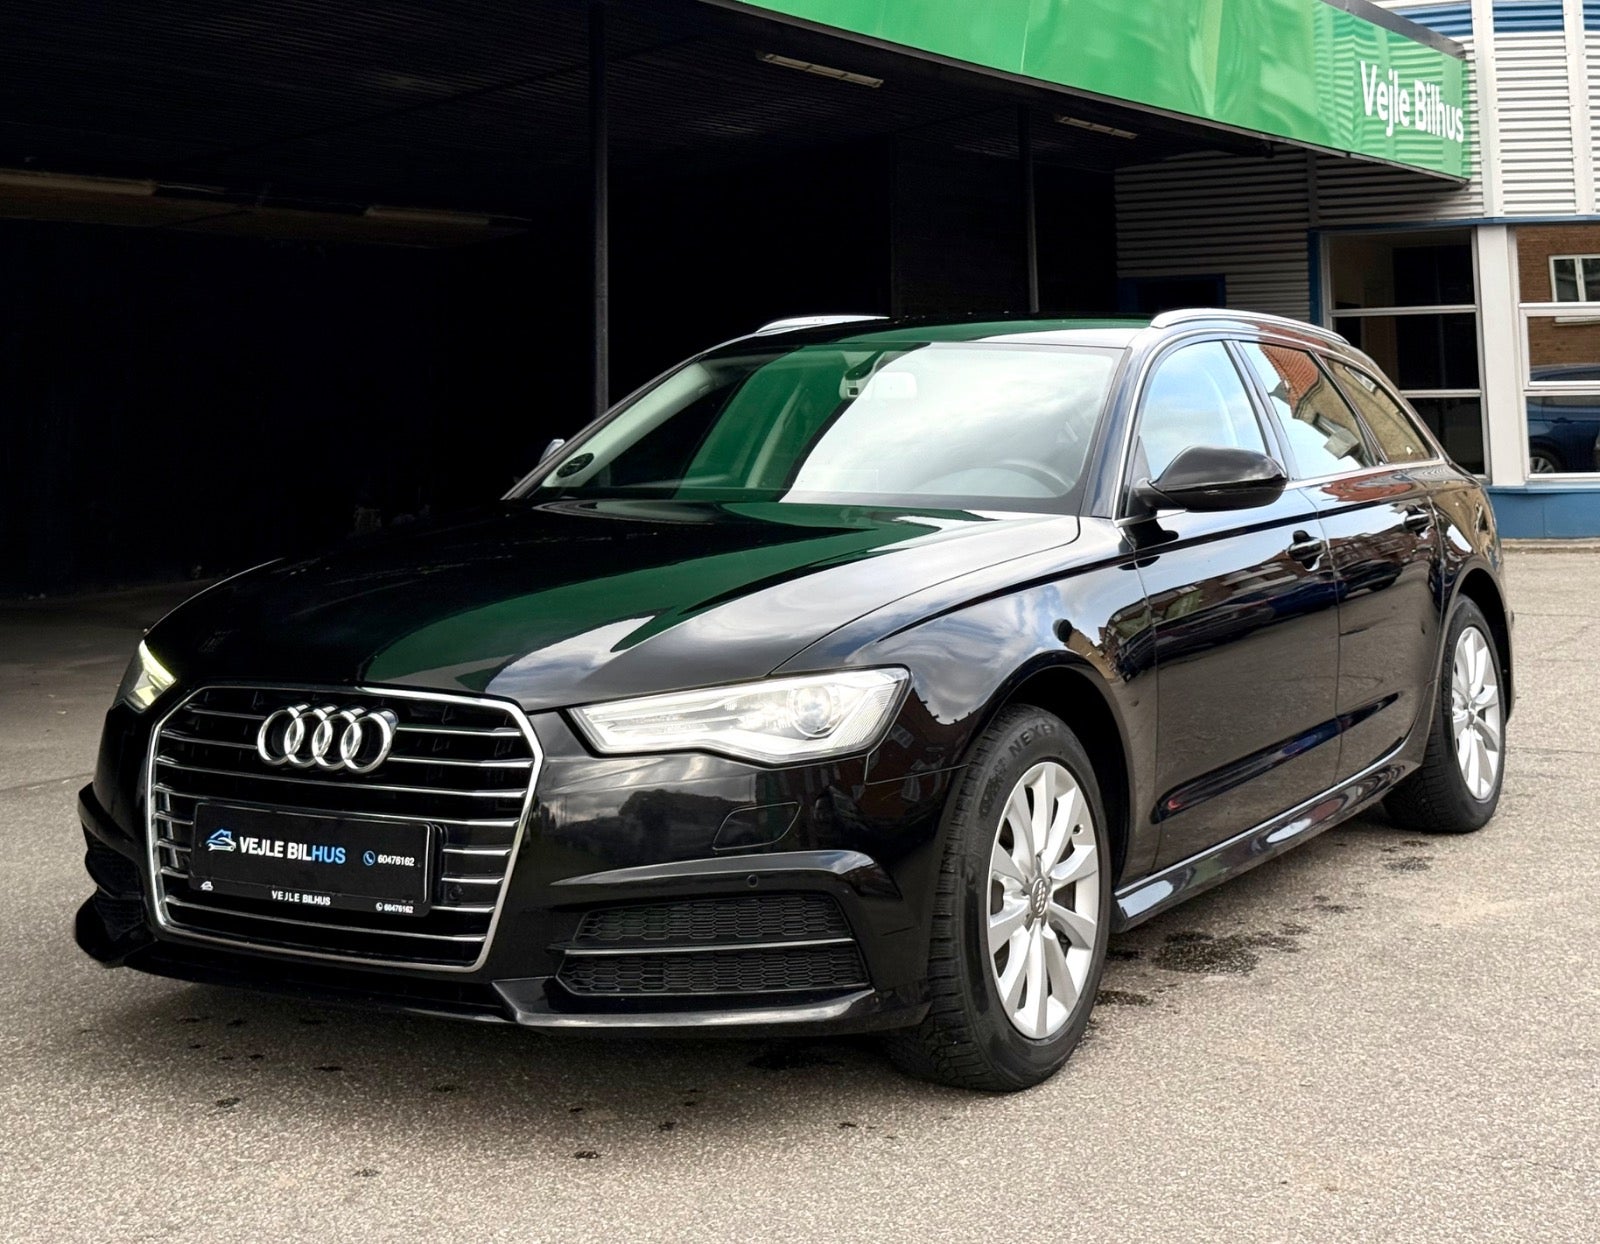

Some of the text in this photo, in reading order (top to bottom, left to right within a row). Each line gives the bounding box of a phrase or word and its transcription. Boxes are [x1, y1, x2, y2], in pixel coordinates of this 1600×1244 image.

[1360, 60, 1464, 143] Vejle Bilhus
[240, 836, 346, 864] VEJLE BILHUS
[377, 854, 415, 867] 60476162
[271, 890, 331, 906] VEJLE BILHUS
